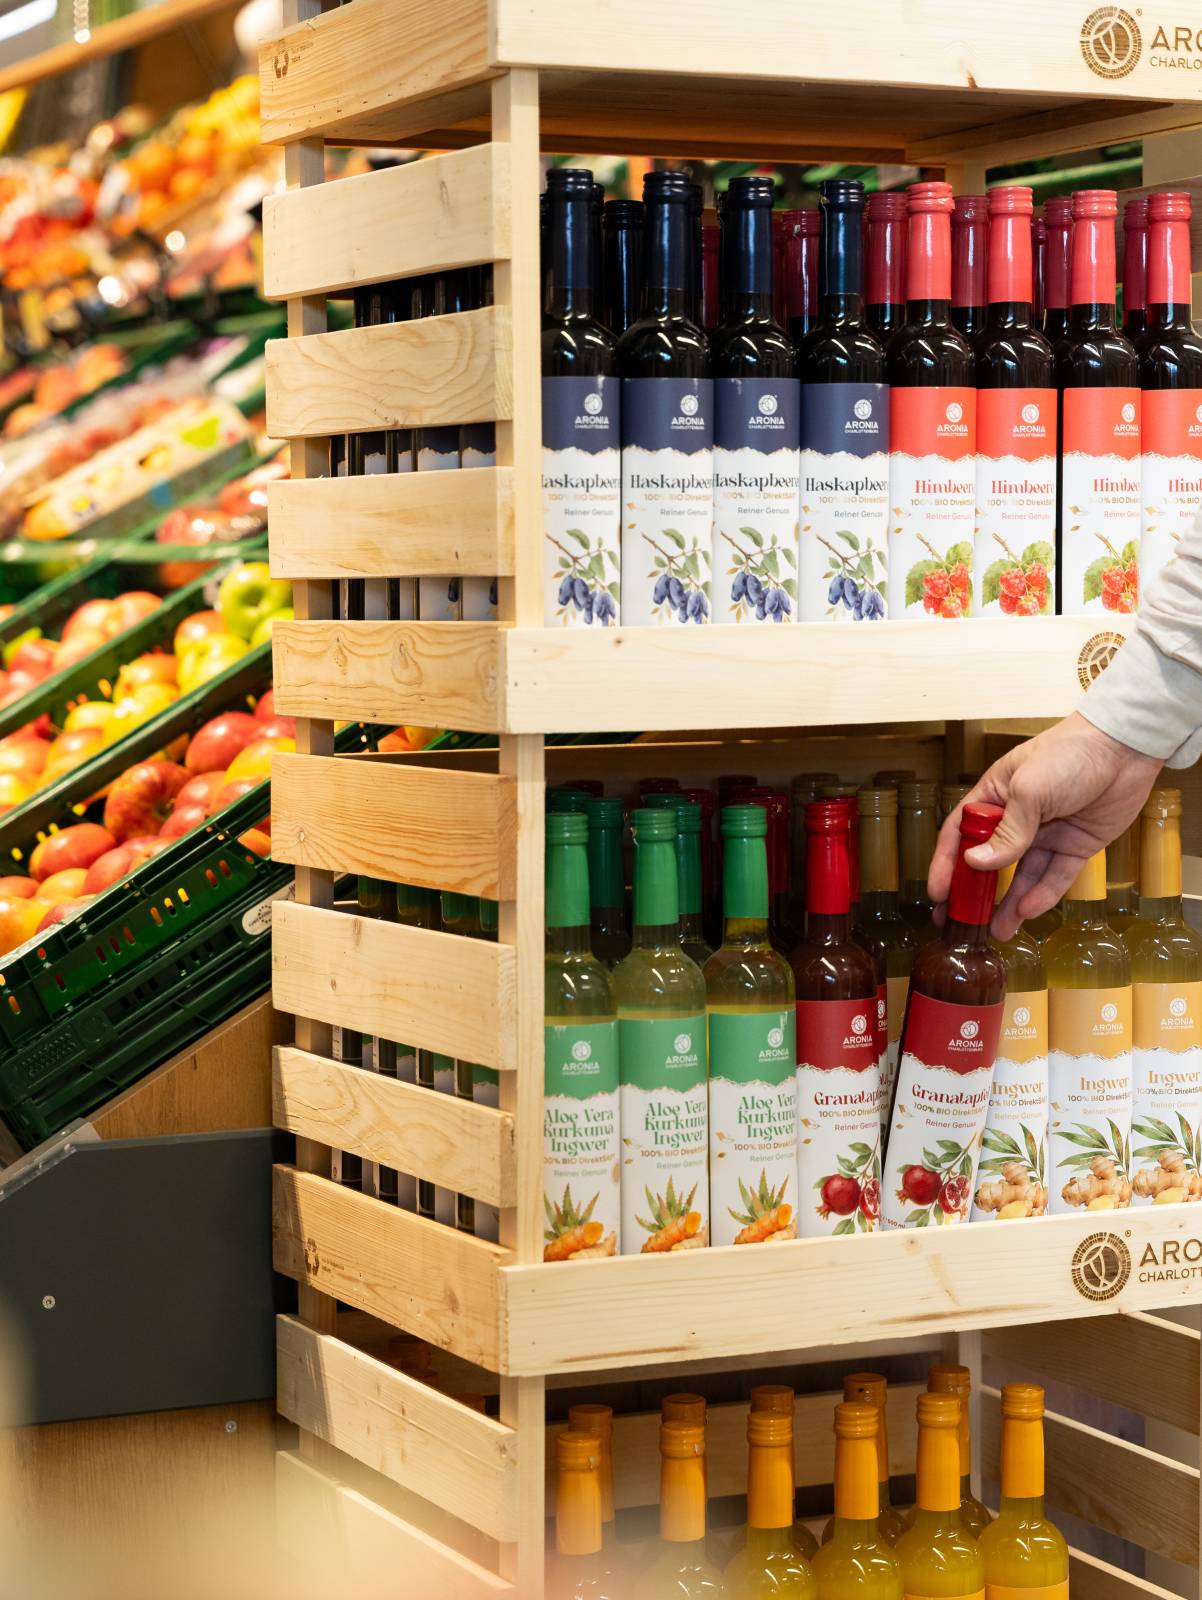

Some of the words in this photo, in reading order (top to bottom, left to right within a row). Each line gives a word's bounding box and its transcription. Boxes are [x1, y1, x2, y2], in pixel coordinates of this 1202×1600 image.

[575, 416, 609, 424] ARONIA
[671, 417, 704, 425] ARONIA
[749, 417, 785, 425] ARONIA
[845, 421, 879, 429] ARONIA
[936, 424, 969, 432] ARONIA
[1012, 425, 1046, 433] ARONIA
[1161, 1017, 1195, 1026] ARONIA
[1004, 1027, 1037, 1036] ARONIA
[1092, 1023, 1124, 1032] ARONIA
[843, 1035, 873, 1045] ARONIA
[948, 1039, 984, 1048] ARONIA
[758, 1048, 789, 1058] ARONIA
[665, 1054, 698, 1064] ARONIA
[562, 1062, 600, 1072] ARONIA
[1149, 1070, 1200, 1088] Ingwer
[993, 1081, 1044, 1099] Ingwer
[1081, 1077, 1129, 1094] Ingwer
[739, 1095, 773, 1110] Aloe
[646, 1102, 680, 1117] Aloe
[914, 1101, 935, 1112] 100%
[936, 1107, 951, 1116] BIO
[584, 1108, 614, 1122] Vera
[747, 1123, 795, 1141] Ingwer
[654, 1130, 704, 1148] Ingwer
[551, 1138, 609, 1156] Ingwer
